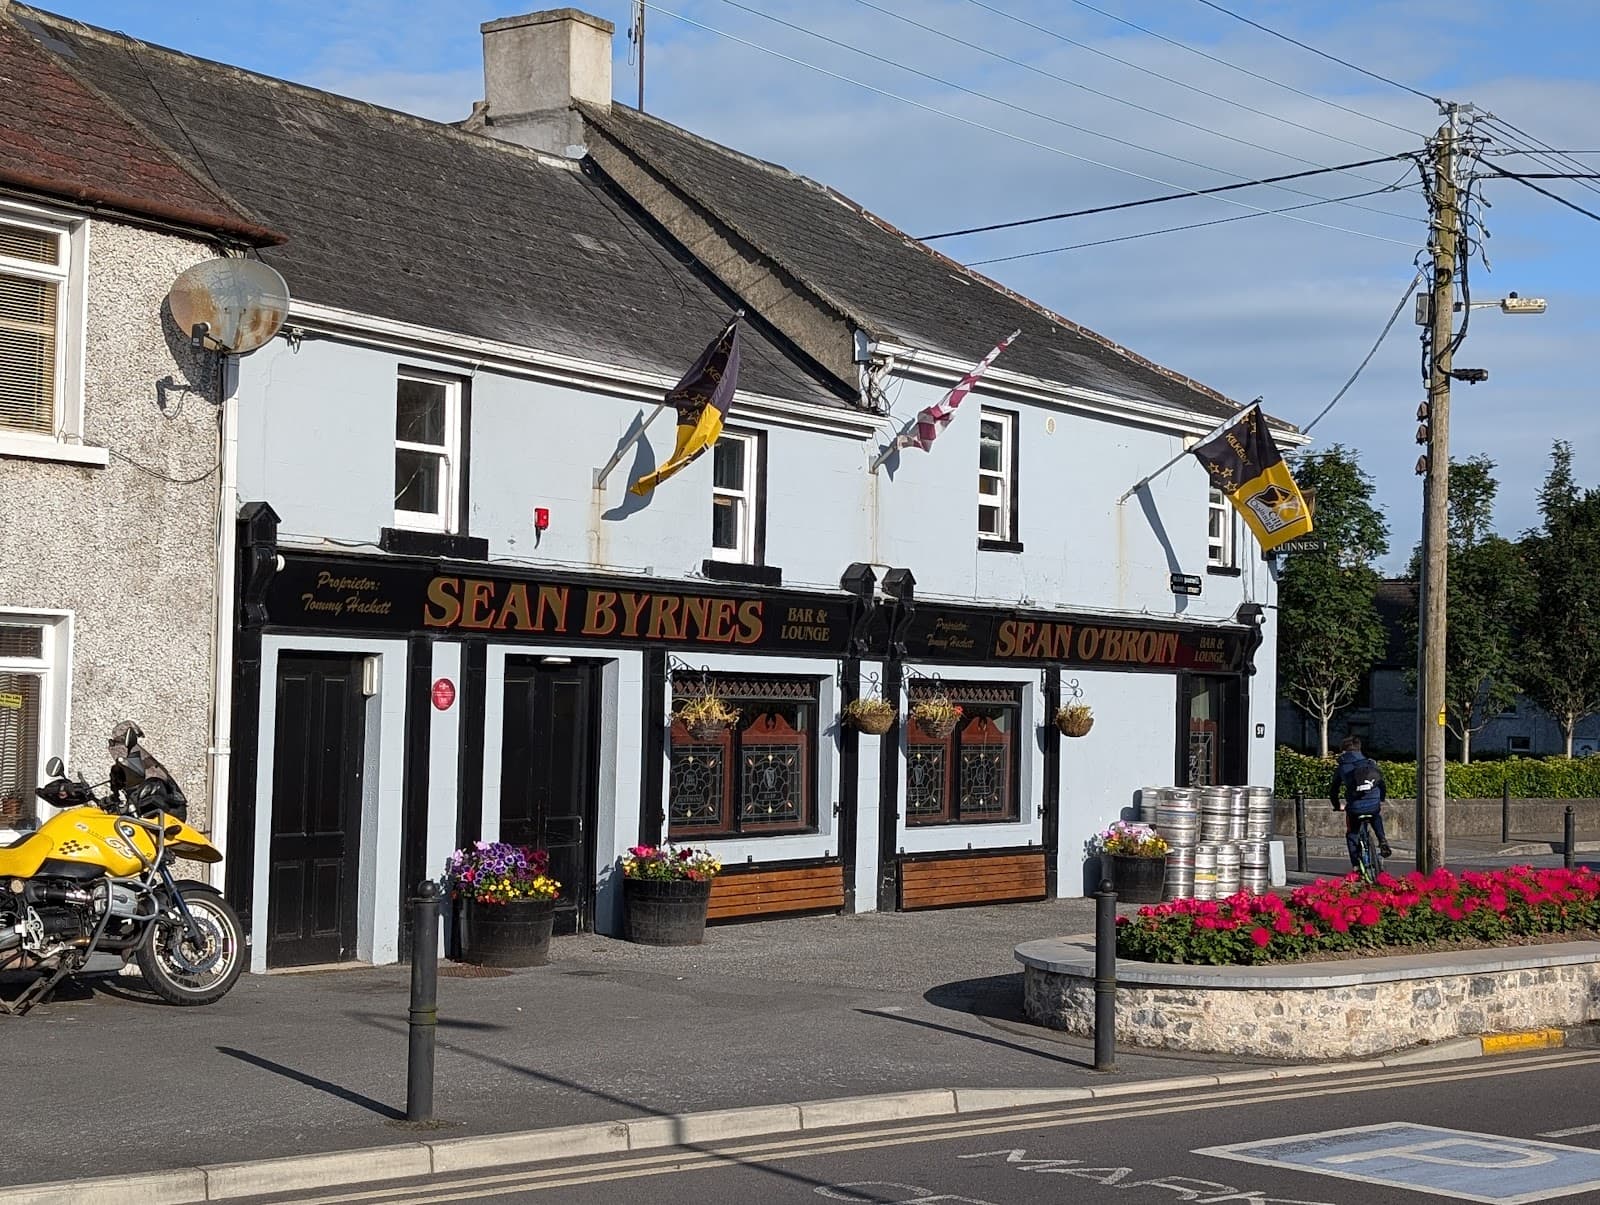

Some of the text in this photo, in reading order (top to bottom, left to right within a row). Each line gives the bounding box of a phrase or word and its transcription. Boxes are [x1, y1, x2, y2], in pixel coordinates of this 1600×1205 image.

[317, 571, 381, 592] Proprietor:
[301, 593, 392, 616] Tommy Hackett
[423, 576, 764, 644] SEAN BYRNES
[788, 607, 828, 624] BAR &
[780, 624, 830, 642] LOUNGE
[995, 620, 1180, 664] SEAN O'BROIN
[1200, 636, 1225, 649] BAR &
[1194, 651, 1225, 663] LOUNGE
[1317, 1137, 1560, 1169] P
